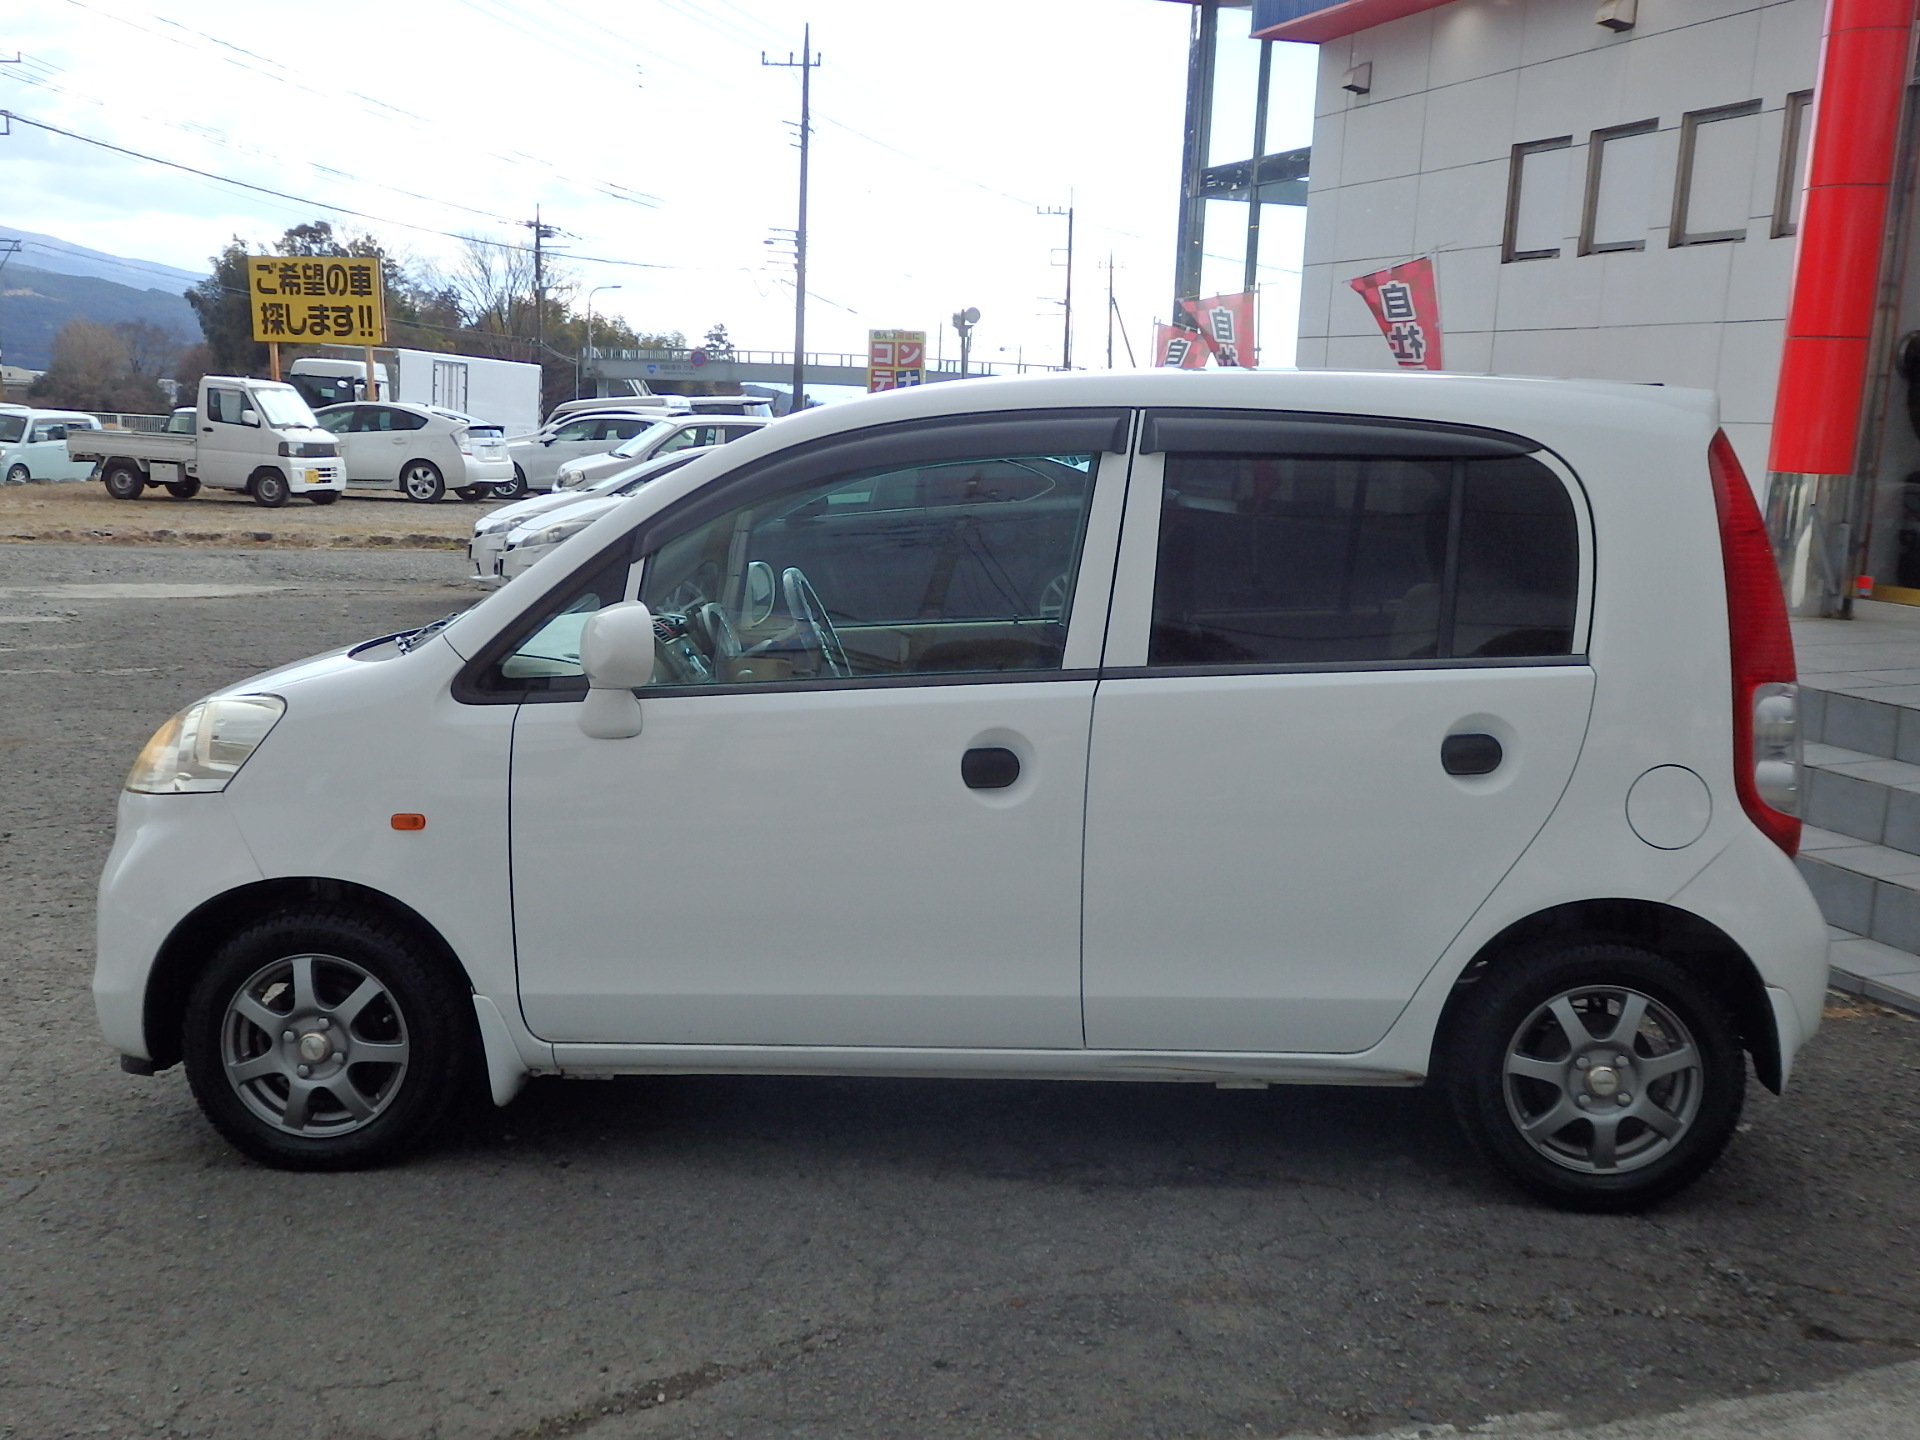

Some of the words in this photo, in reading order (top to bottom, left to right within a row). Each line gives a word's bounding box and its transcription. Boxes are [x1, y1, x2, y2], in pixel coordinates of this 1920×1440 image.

[256, 262, 373, 297] ご希望の車
[260, 302, 374, 337] 探します!!
